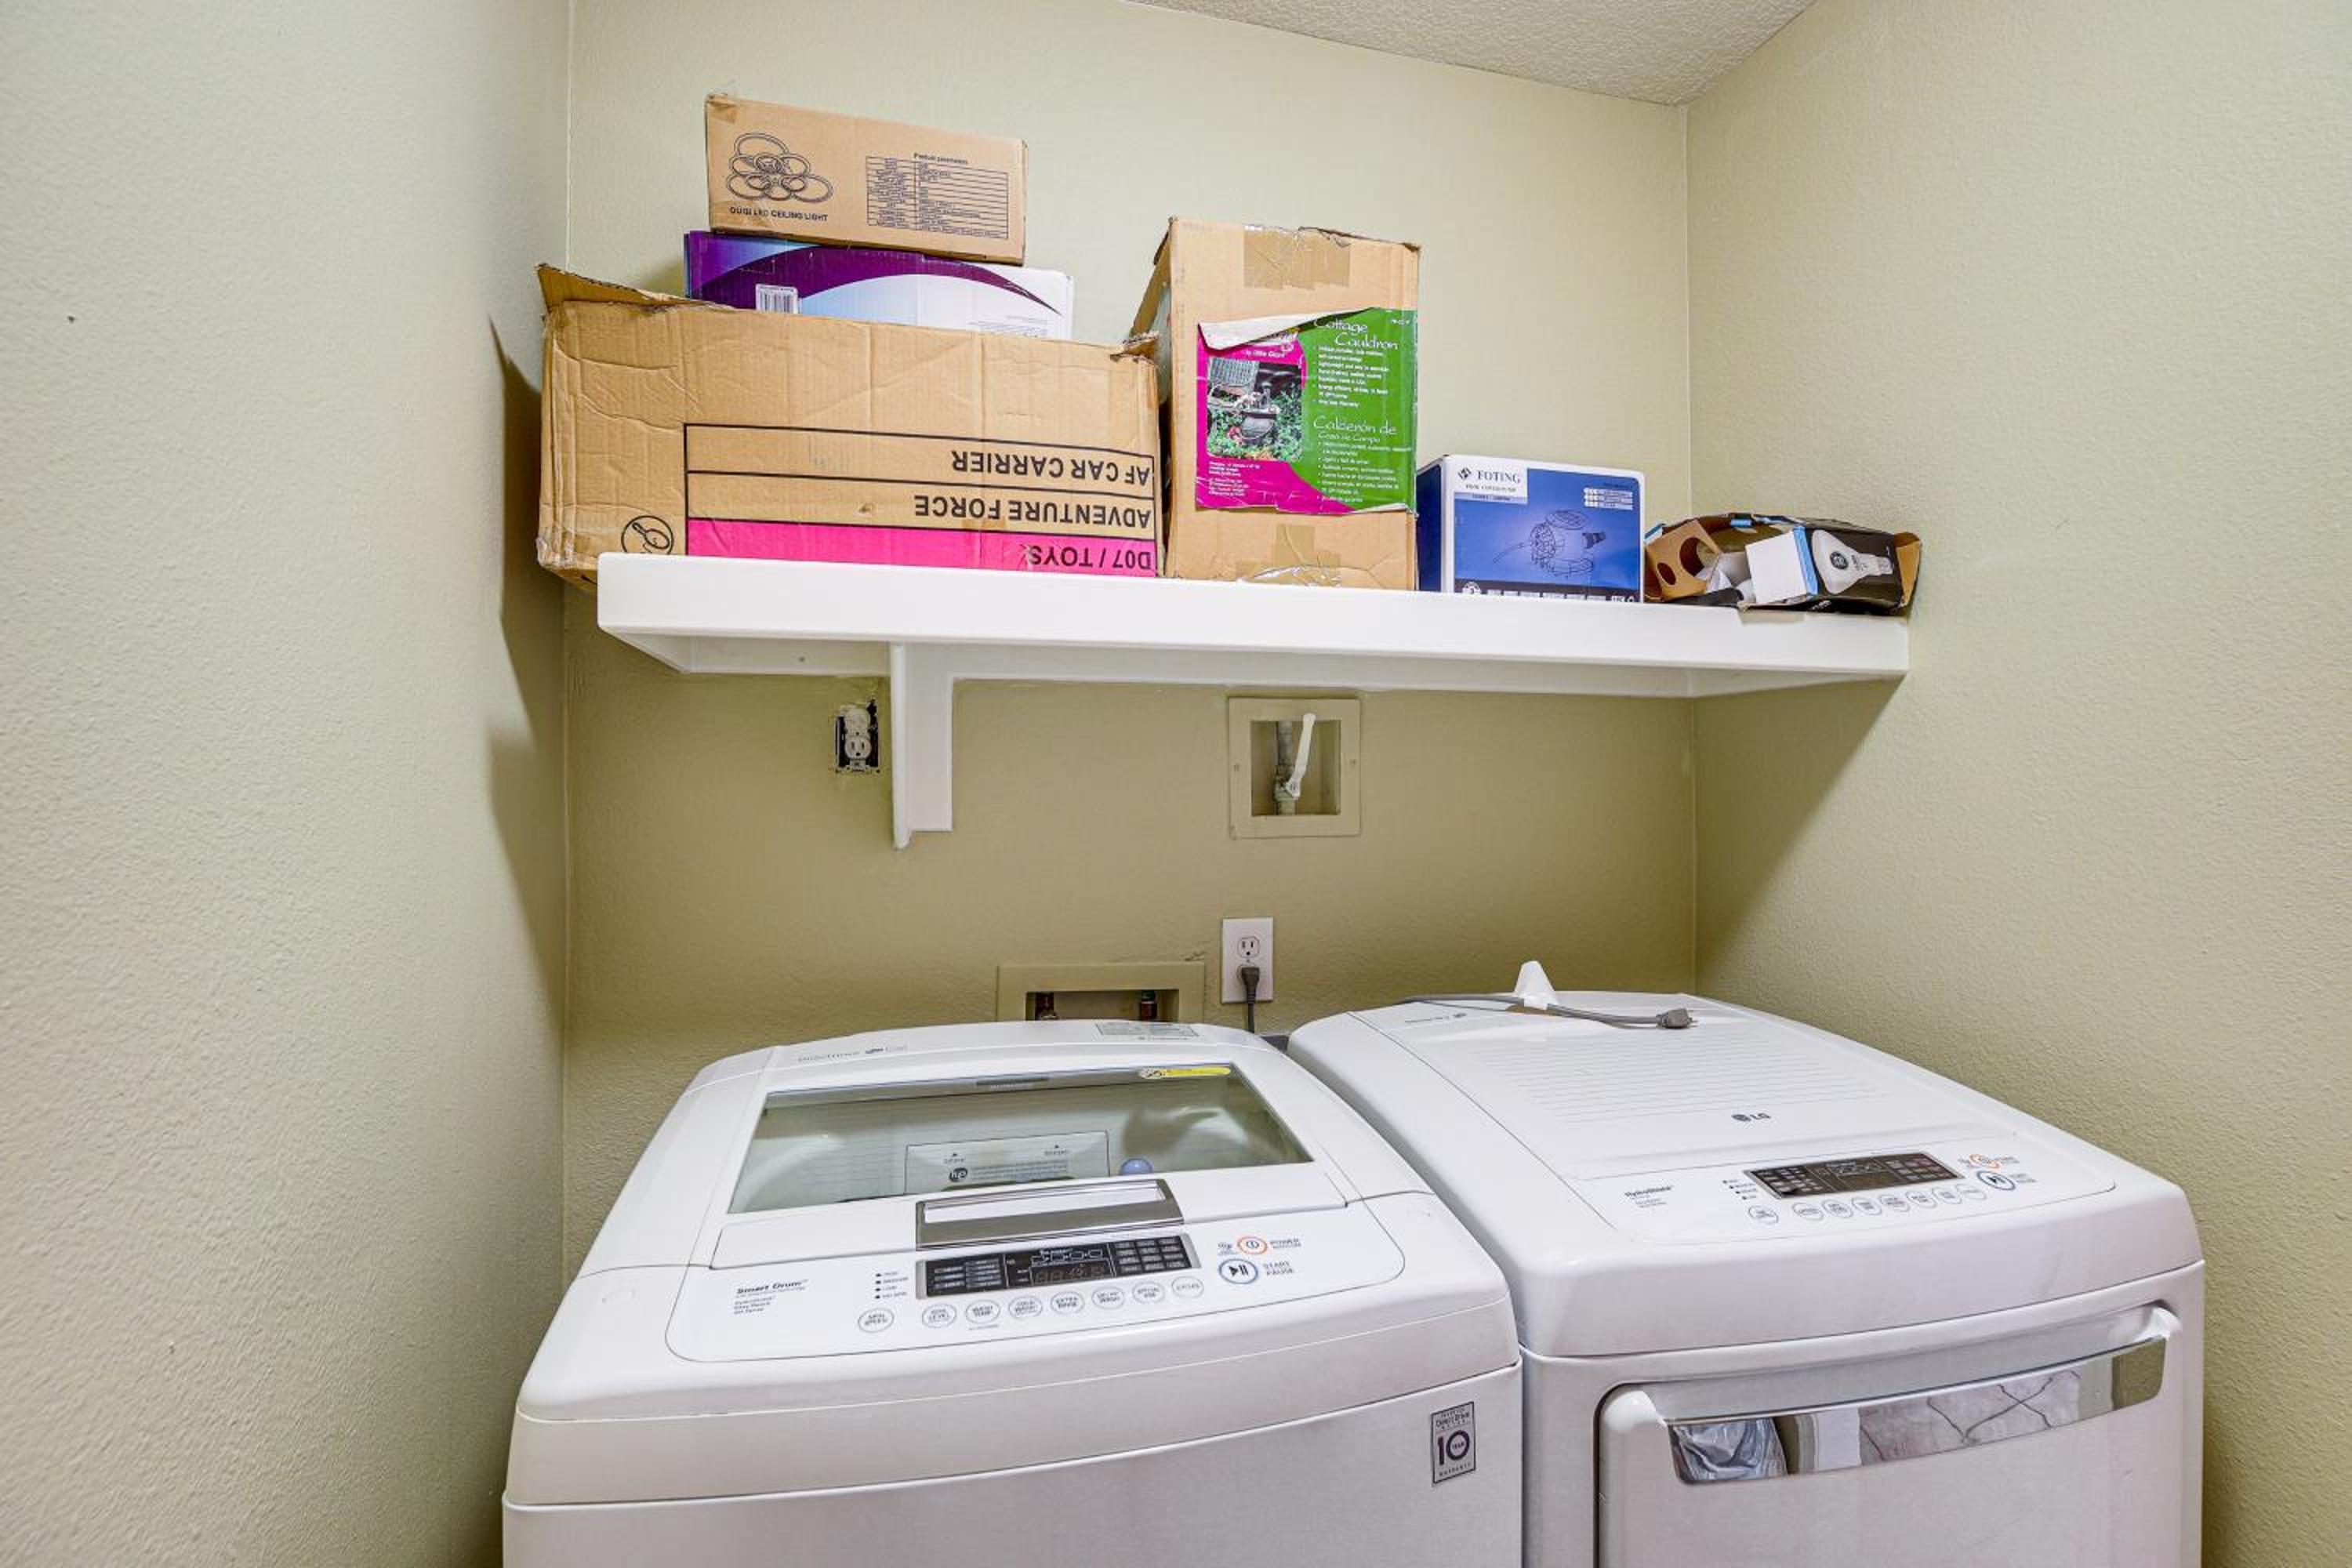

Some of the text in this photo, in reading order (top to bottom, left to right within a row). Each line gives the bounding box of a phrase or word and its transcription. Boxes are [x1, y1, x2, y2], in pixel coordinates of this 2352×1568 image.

[771, 209, 803, 220] CEILING
[804, 212, 828, 221] LIGHT
[1314, 318, 1367, 335] Cottage
[1335, 332, 1399, 350] Cauldron
[1380, 419, 1396, 435] de
[951, 451, 1150, 486] AF CAR CARRIER
[1476, 470, 1520, 484] FOTING
[914, 495, 1151, 528] ADVENTURE FORCE
[1029, 545, 1093, 568] TOYS
[1112, 549, 1151, 570] D07
[1437, 1430, 1470, 1466] 10
